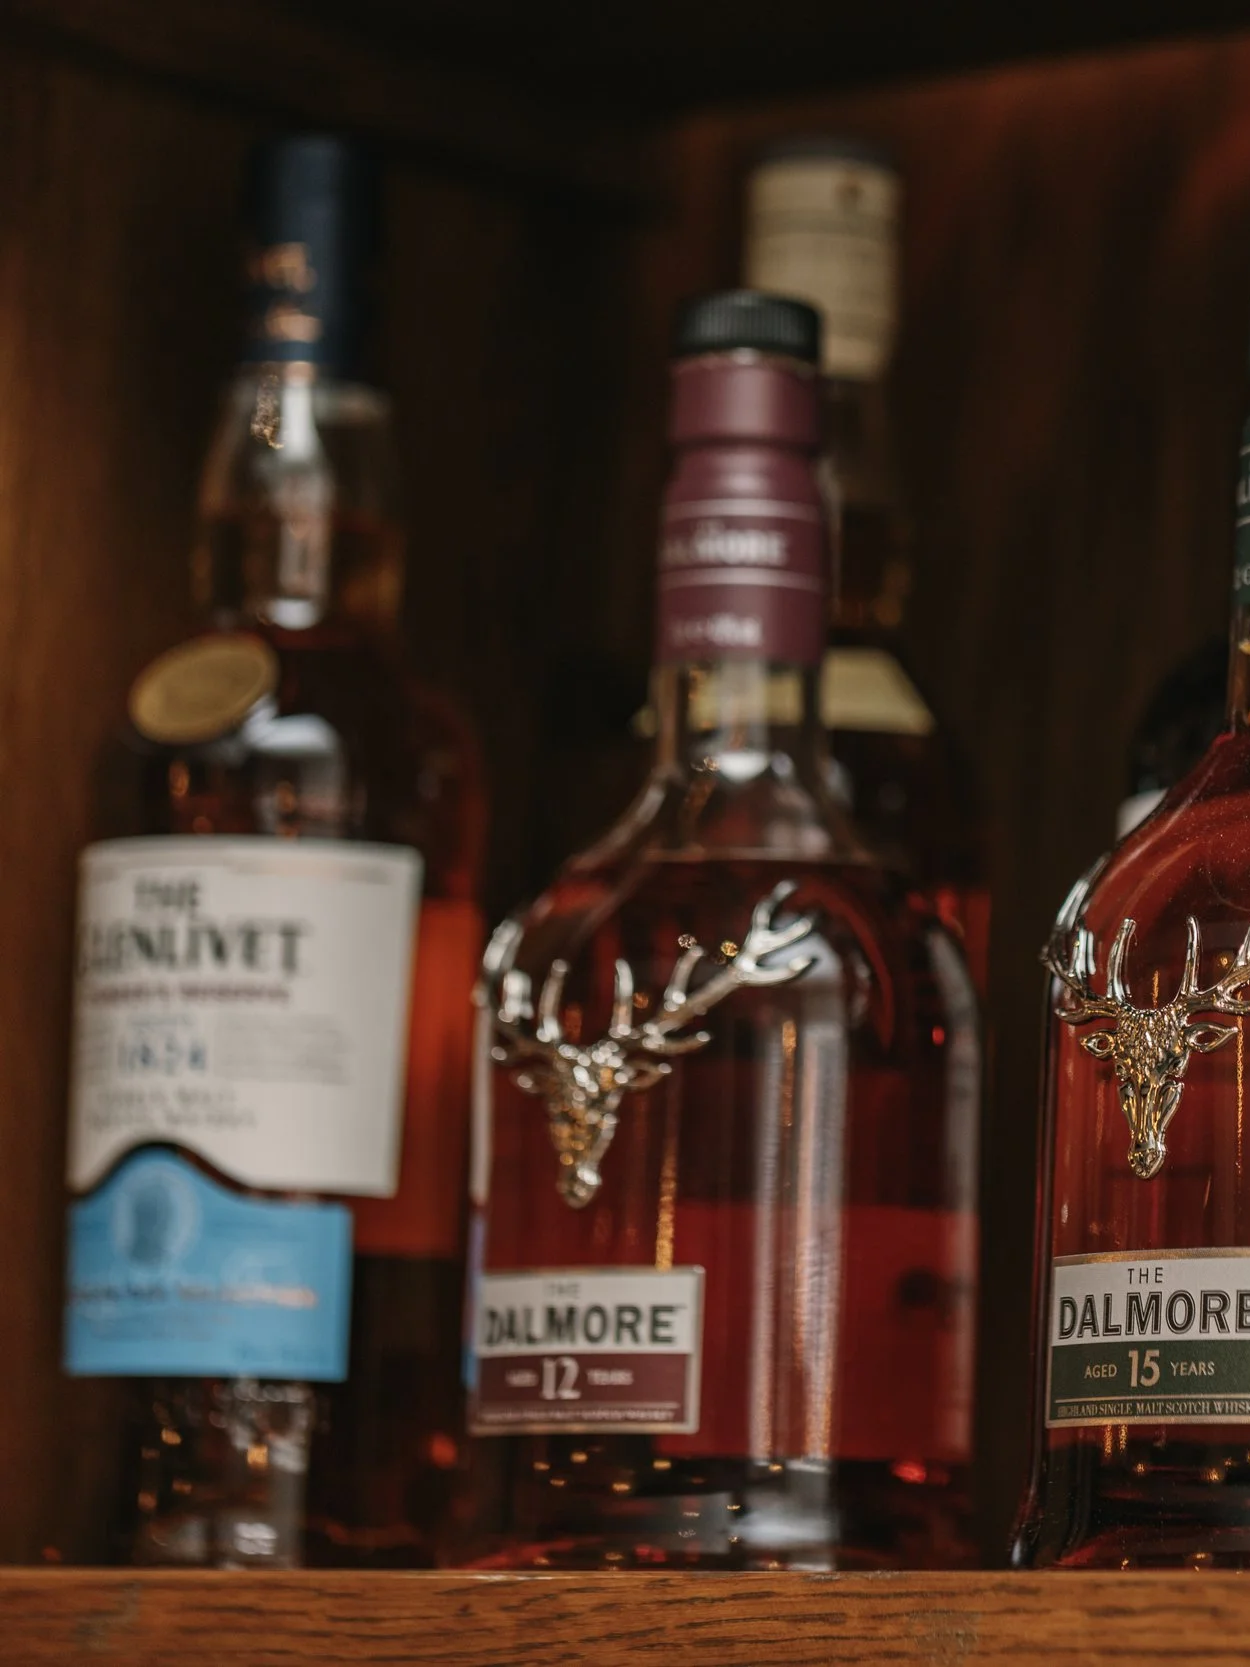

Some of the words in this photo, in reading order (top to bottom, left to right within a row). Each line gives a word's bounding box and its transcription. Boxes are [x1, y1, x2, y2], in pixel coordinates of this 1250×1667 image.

[1128, 1267, 1163, 1284] THE
[485, 1304, 677, 1347] DALMORE
[541, 1356, 581, 1400] 12
[1084, 1363, 1118, 1379] AGED
[1128, 1350, 1161, 1388] 15
[1170, 1360, 1216, 1377] YEARS
[1099, 1402, 1133, 1416] SINGLE
[1136, 1401, 1165, 1415] MALT
[1165, 1401, 1210, 1415] SCOTCH
